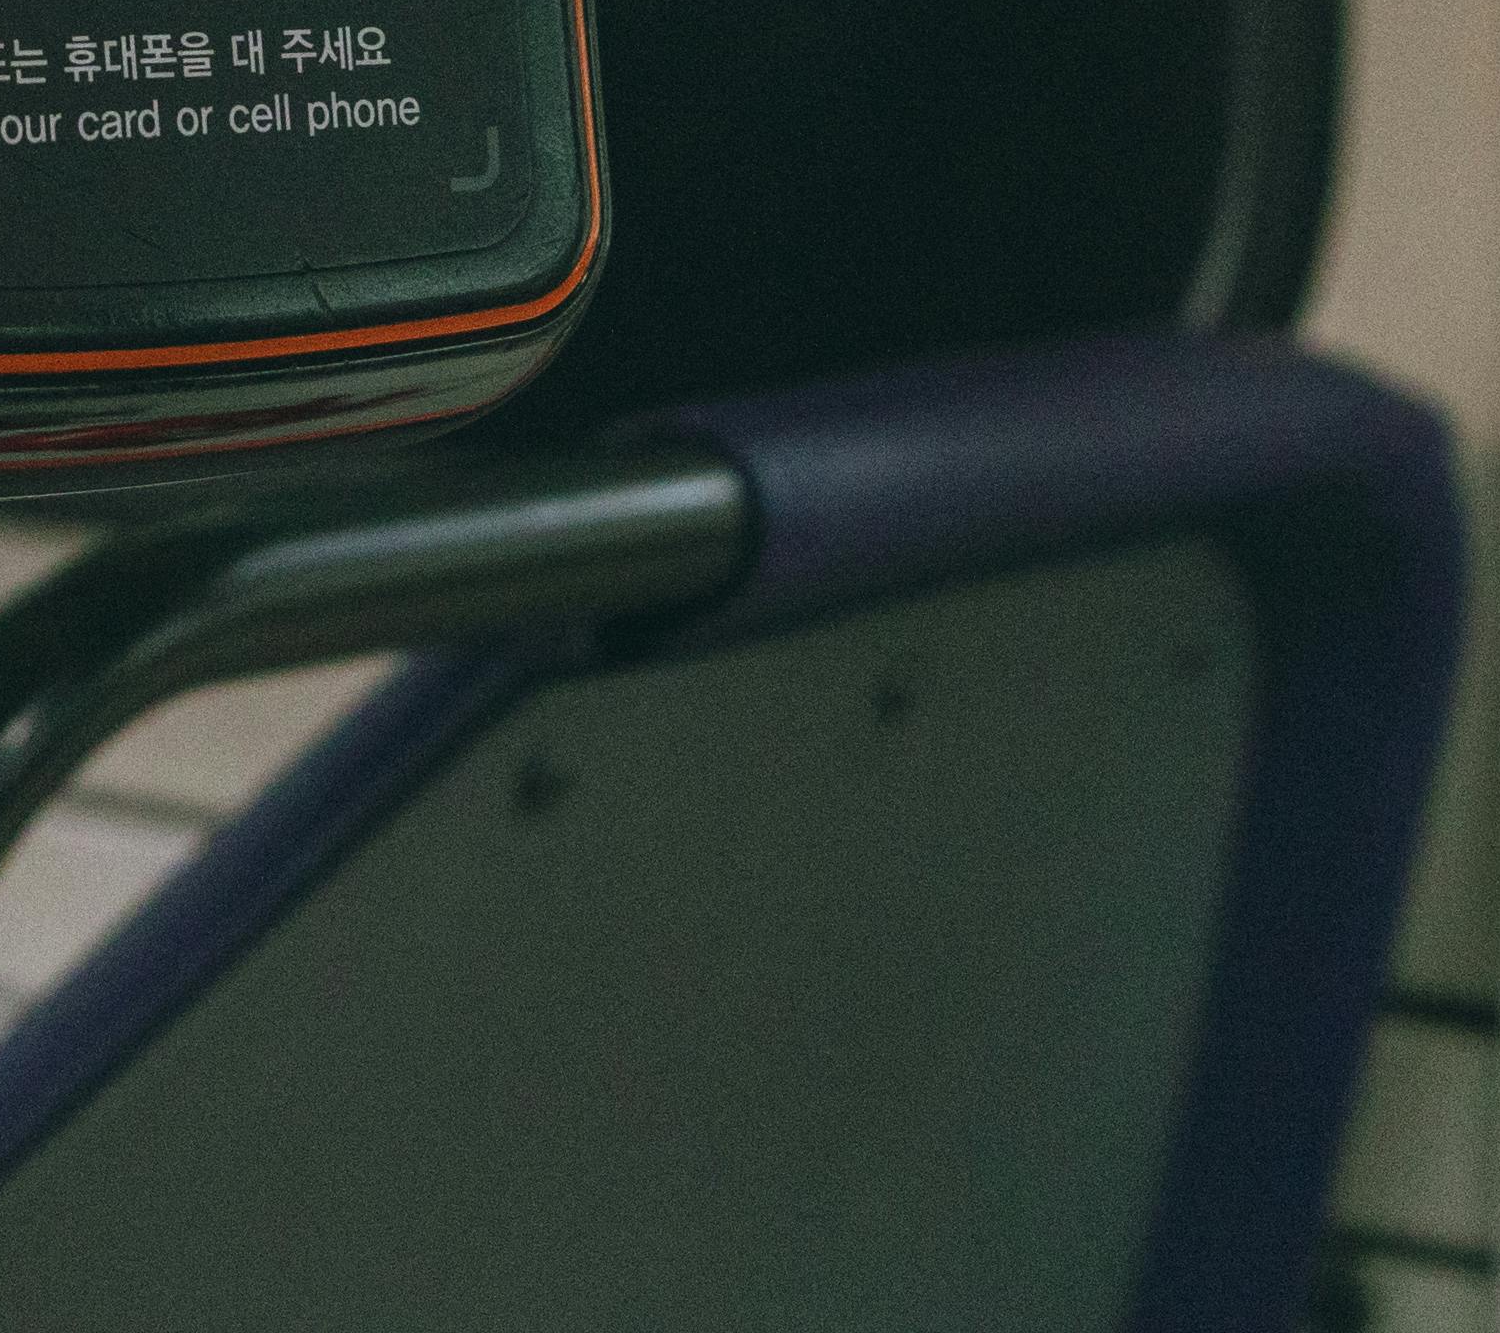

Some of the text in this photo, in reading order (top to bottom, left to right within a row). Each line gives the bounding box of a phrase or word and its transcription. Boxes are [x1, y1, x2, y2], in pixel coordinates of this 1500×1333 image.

[63, 31, 215, 84] 휴대폰을
[230, 29, 266, 75] 대
[280, 25, 392, 74] 주세요
[77, 98, 162, 142] card
[176, 105, 214, 138] or
[228, 92, 292, 134] cell
[306, 90, 421, 137] phone
